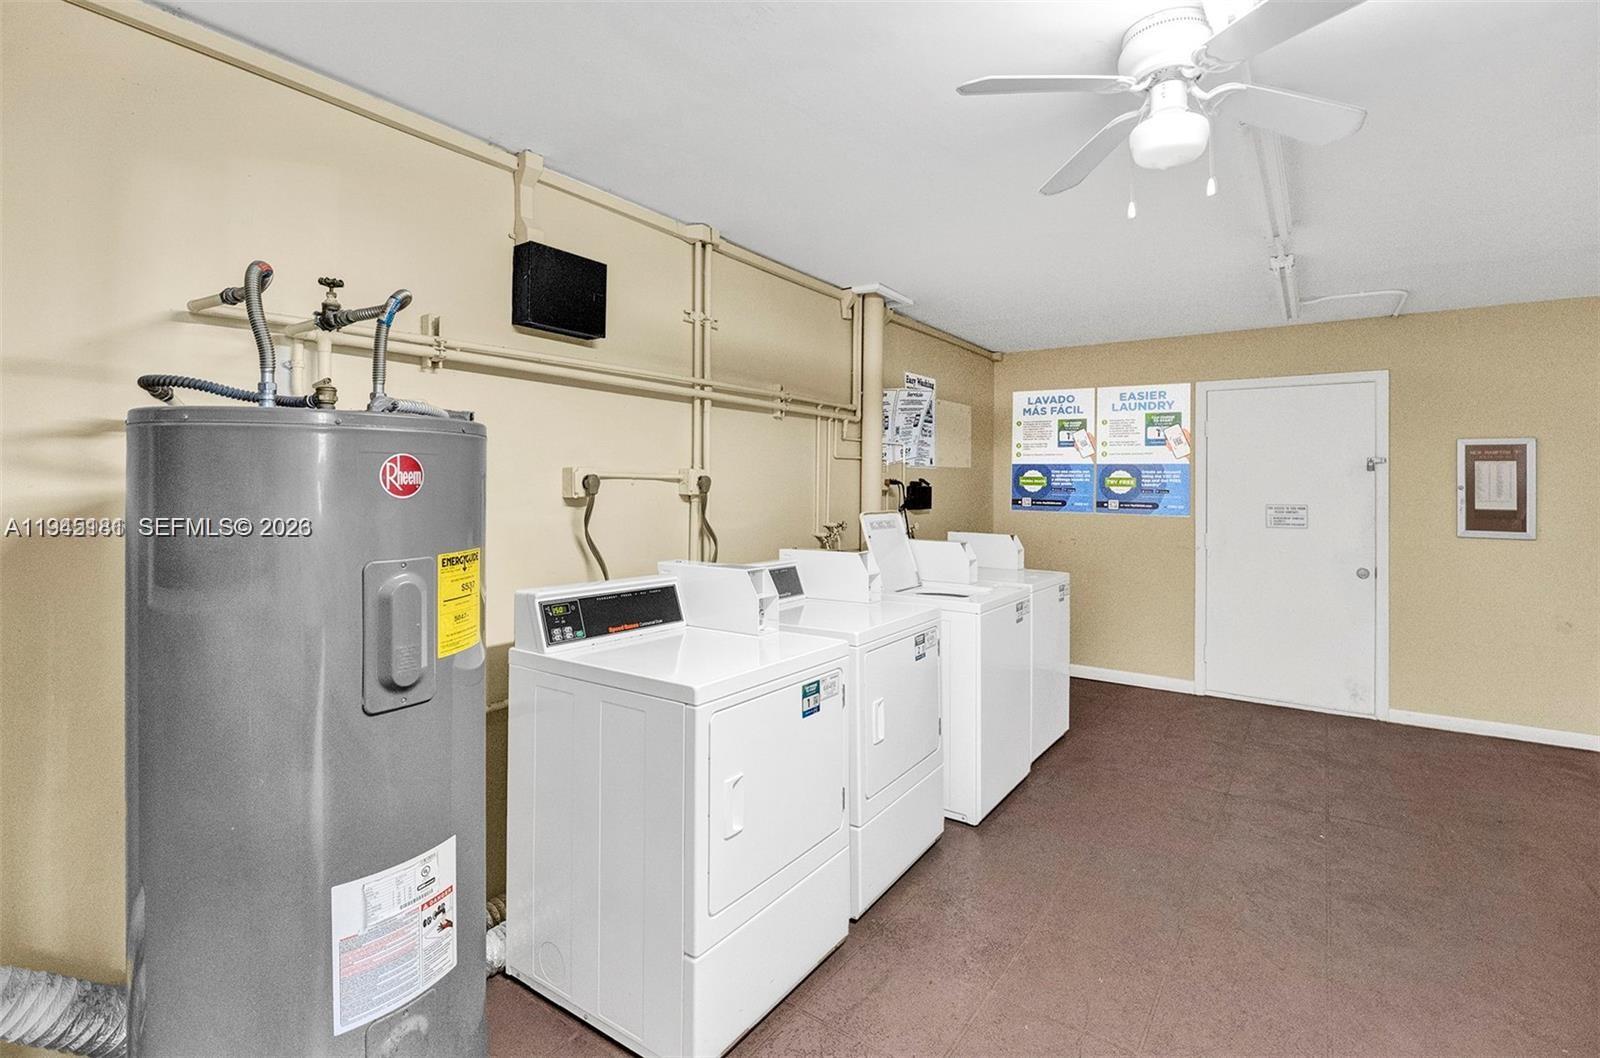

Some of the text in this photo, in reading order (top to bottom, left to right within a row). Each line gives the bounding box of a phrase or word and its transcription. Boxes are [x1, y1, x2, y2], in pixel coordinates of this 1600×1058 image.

[1028, 394, 1076, 406] LAVADO
[1120, 390, 1167, 402] EASIER
[1022, 404, 1084, 416] MÁS FÁCIL
[1112, 400, 1175, 412] LAUNDRY
[386, 455, 421, 490] Rheem
